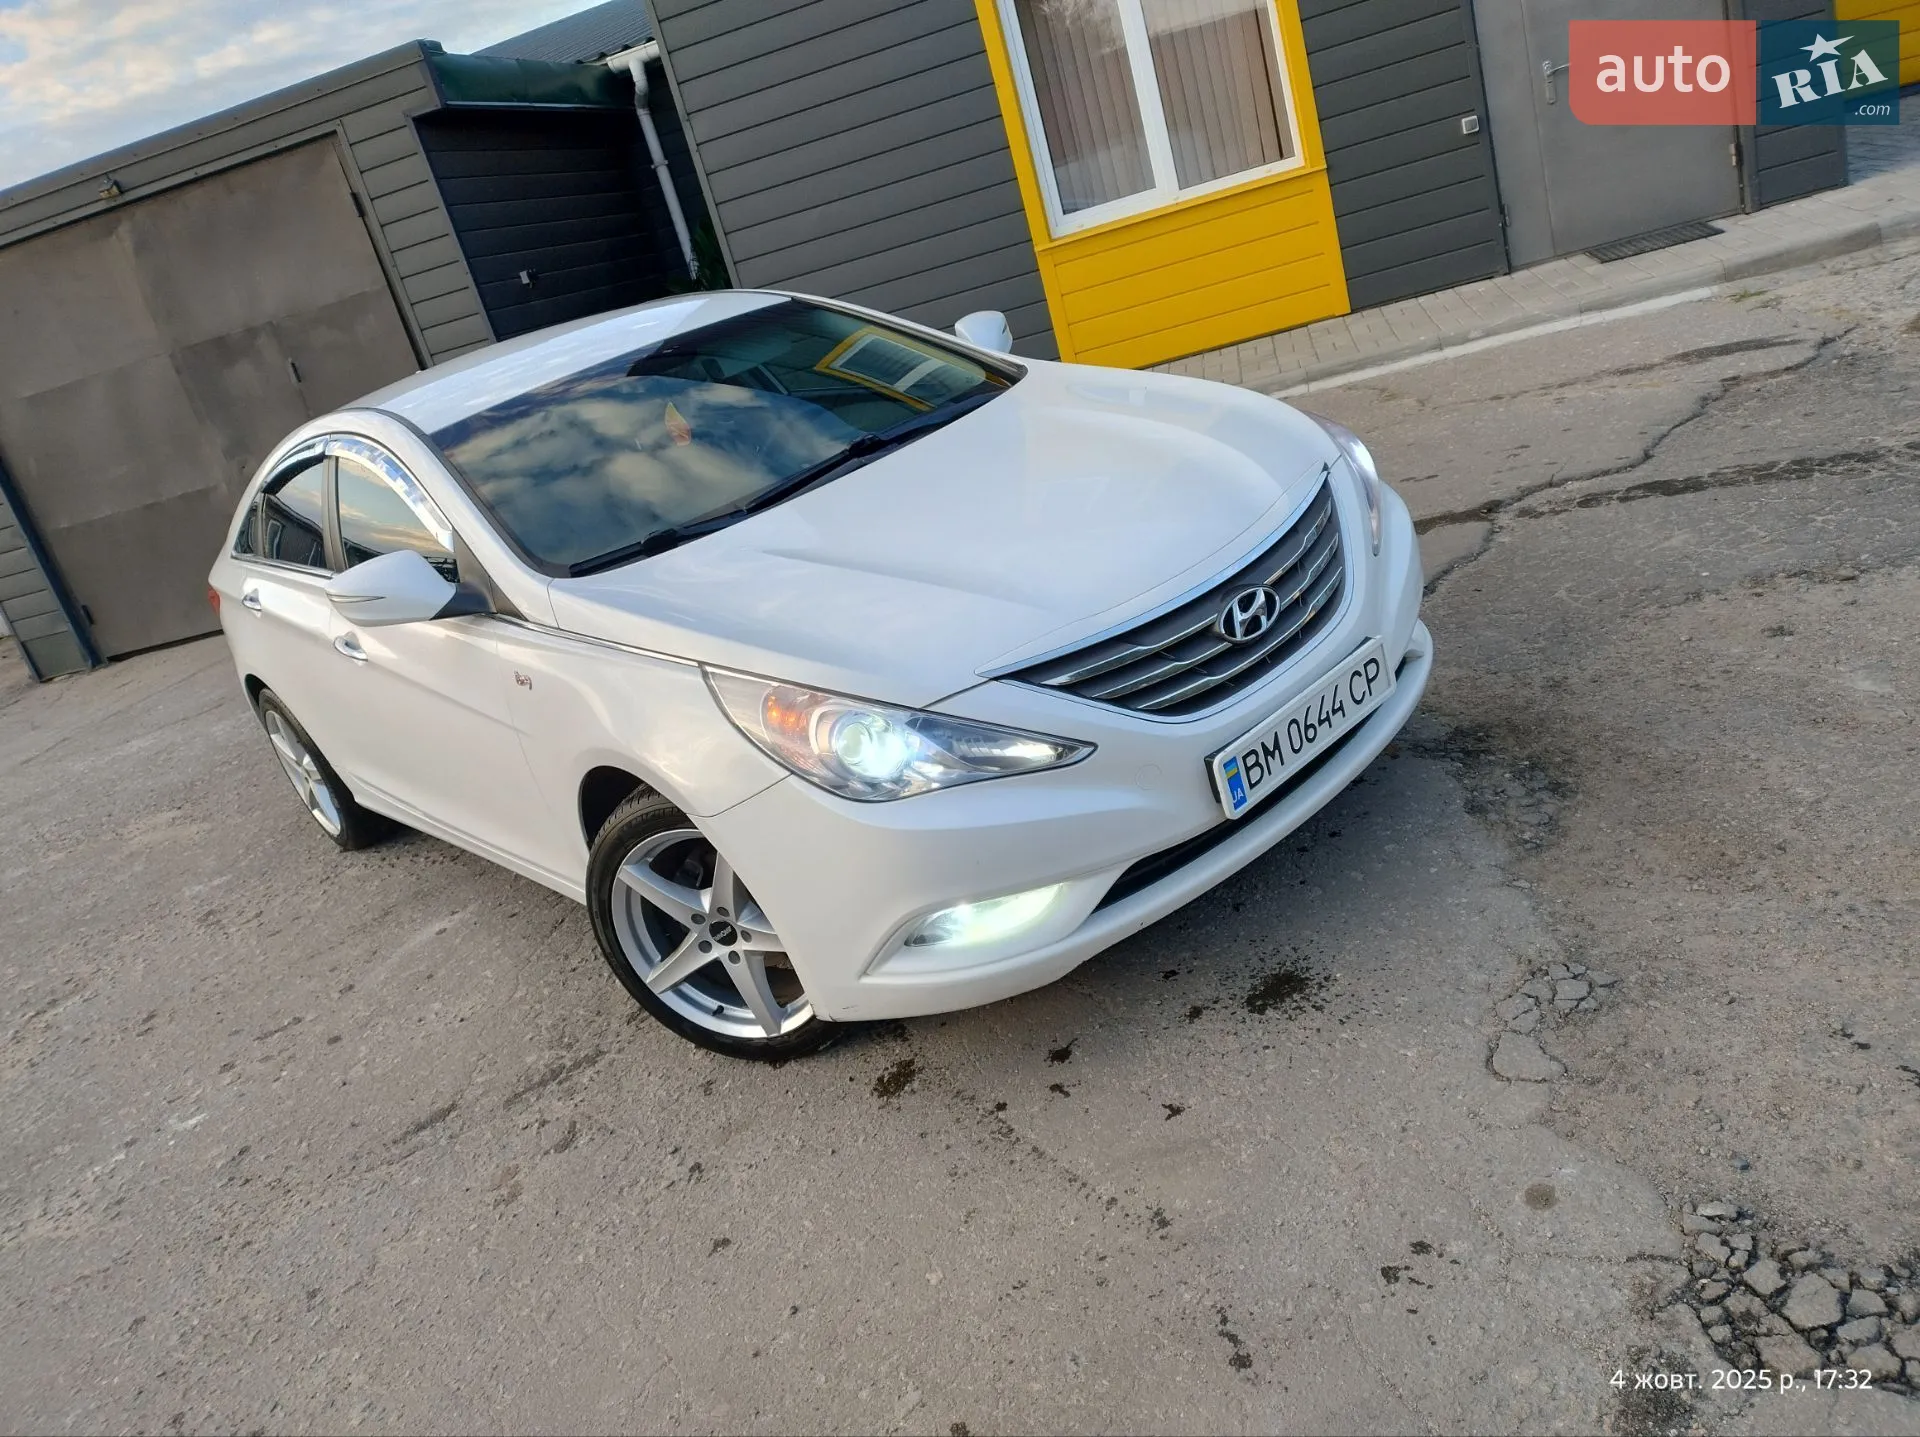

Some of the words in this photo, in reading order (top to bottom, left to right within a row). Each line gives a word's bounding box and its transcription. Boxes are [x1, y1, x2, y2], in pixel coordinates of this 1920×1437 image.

[1241, 730, 1285, 790] BM
[1287, 684, 1346, 755] 0644
[1349, 657, 1380, 705] CP
